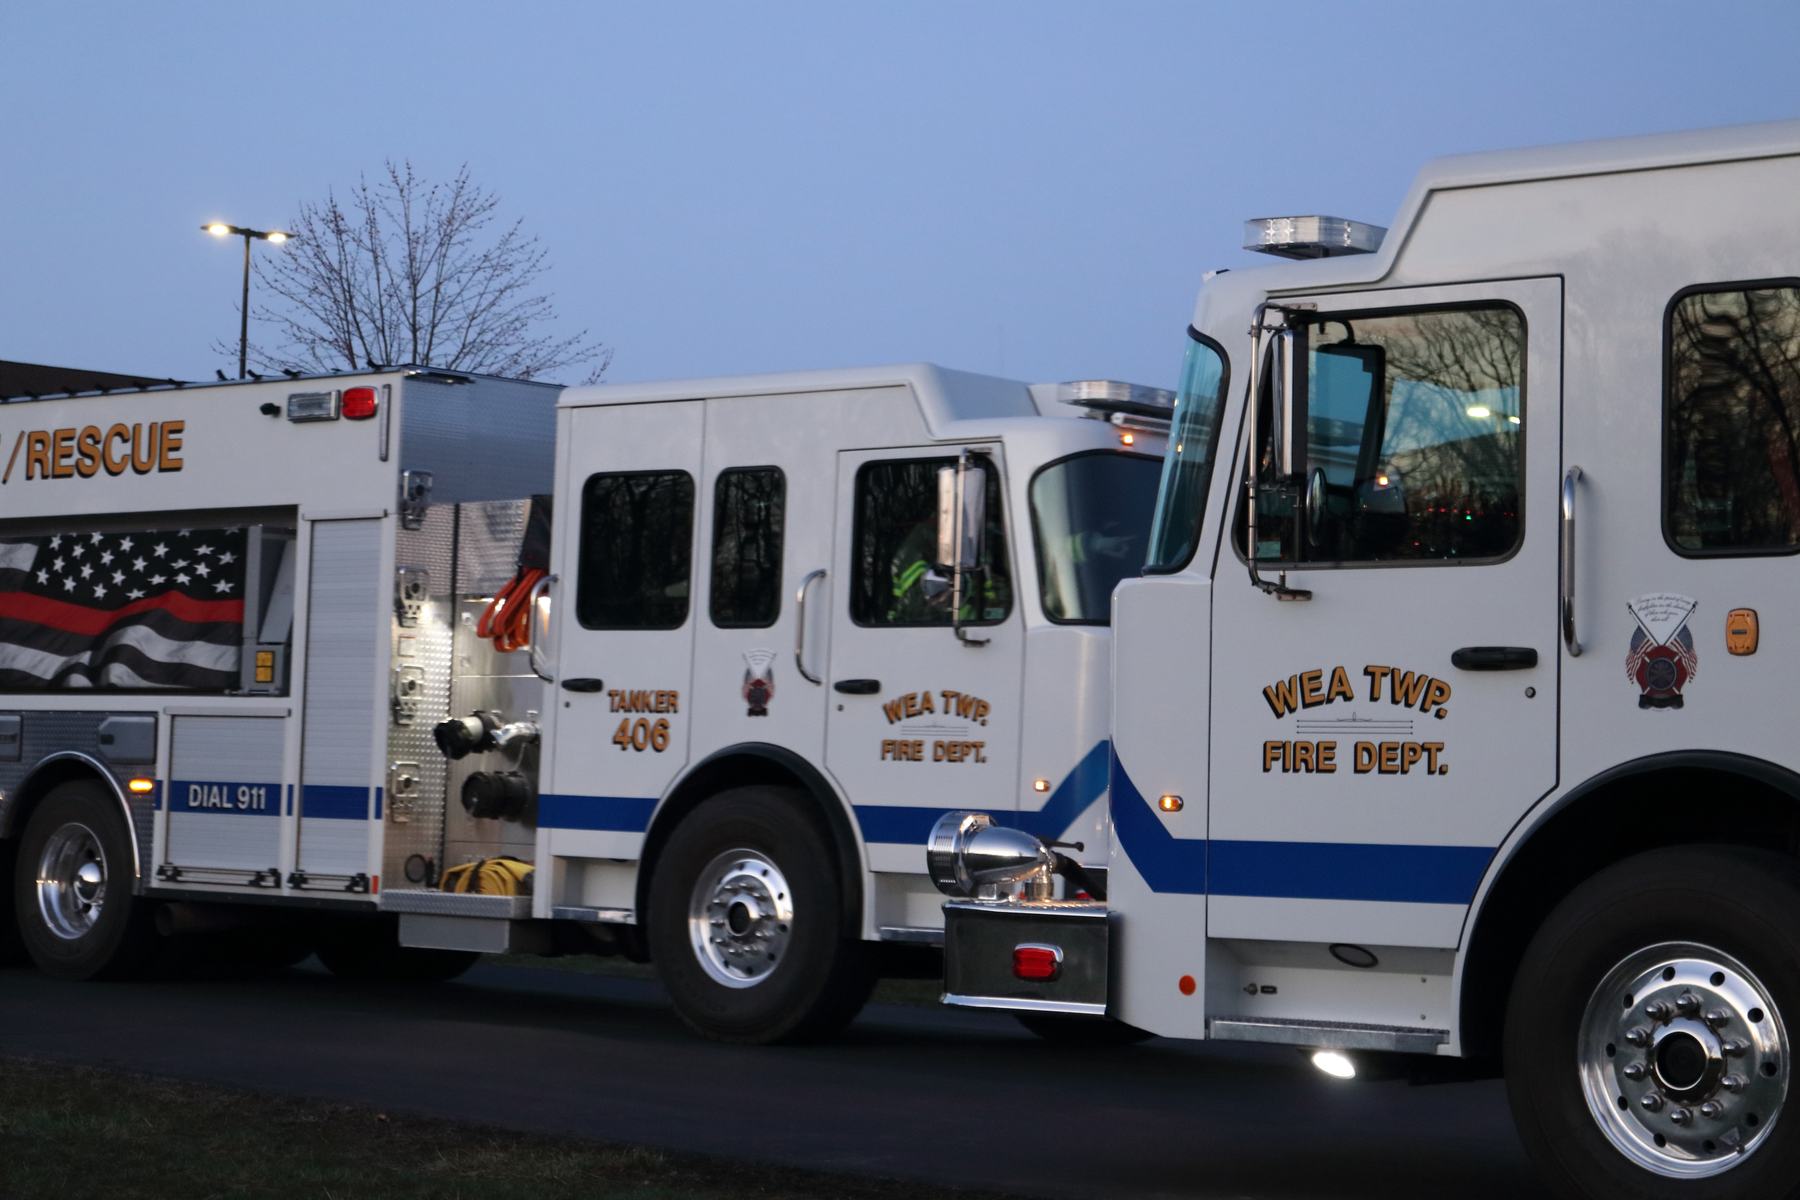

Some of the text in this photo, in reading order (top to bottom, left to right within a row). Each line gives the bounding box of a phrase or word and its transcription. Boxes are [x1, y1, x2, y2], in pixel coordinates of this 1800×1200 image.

[0, 420, 185, 485] /RESCUE
[607, 689, 679, 713] TANKER
[882, 690, 991, 727] WEA TWP.
[1262, 664, 1452, 720] WEA TWP.
[612, 717, 671, 753] 406
[881, 739, 986, 764] FIRE DEPT.
[1262, 740, 1449, 776] FIRE DEPT.
[188, 784, 267, 809] DIAL 911
